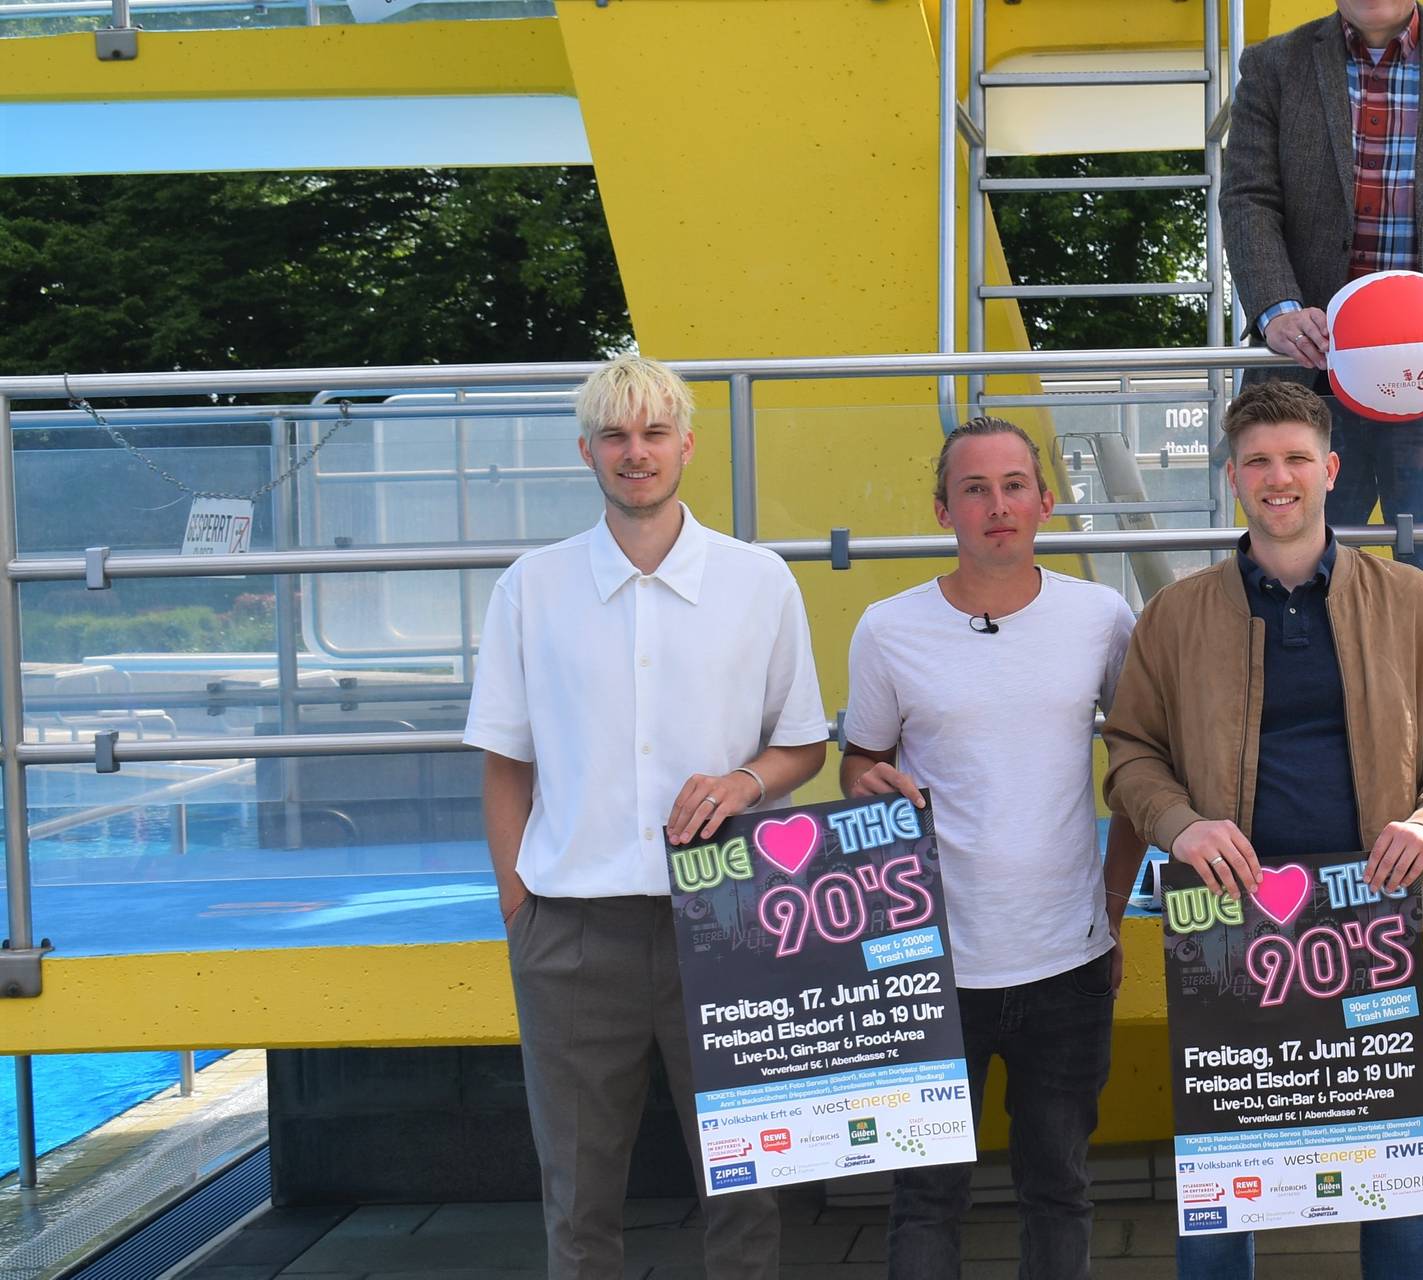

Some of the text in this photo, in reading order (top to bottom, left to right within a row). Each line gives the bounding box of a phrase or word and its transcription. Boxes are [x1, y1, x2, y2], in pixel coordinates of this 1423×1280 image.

[187, 514, 232, 542] GESPERRT
[671, 798, 921, 892] WE THE
[758, 855, 934, 958] 90'S
[1166, 886, 1244, 934] WE
[868, 941, 891, 955] 90er
[902, 933, 934, 948] 2000er
[876, 945, 934, 965] Trash Music
[1246, 914, 1414, 1008] 90'S
[830, 978, 880, 1006] Juni
[884, 971, 942, 998] 2022
[1349, 1000, 1370, 1012] 90er
[1380, 993, 1412, 1006] 2000er
[1354, 1004, 1410, 1022] Trash Music
[702, 1002, 945, 1050] Freibad Elsdorf ab 19 Uhr
[790, 1040, 841, 1057] Gin-Bar
[855, 1029, 925, 1047] Food-Area
[1309, 1036, 1356, 1060] Juni
[1361, 1031, 1414, 1056] 2022
[760, 1048, 899, 1076] Vorverkauf 5€ Abendkasse 7€
[1185, 1062, 1415, 1094] Freibad Elsdorf ab 19 Uhr
[812, 1089, 911, 1115] westenergie
[920, 1085, 966, 1103] RWE
[1266, 1093, 1315, 1107] Gin-Bar
[1329, 1087, 1394, 1103] Food-Area
[720, 1111, 769, 1126] Volksbank
[770, 1109, 787, 1119] Erft
[1237, 1105, 1369, 1124] Vorverkauf 5€ Abendkasse 7€
[763, 1131, 787, 1143] REWE
[909, 1120, 966, 1137] ELSDORF
[1196, 1159, 1242, 1170] Volksbank
[1244, 1157, 1260, 1167] Erft
[1283, 1146, 1377, 1166] westenergie
[715, 1166, 751, 1179] ZIPPEL
[1235, 1179, 1258, 1189] REWE
[1188, 1210, 1222, 1221] ZIPPEL
